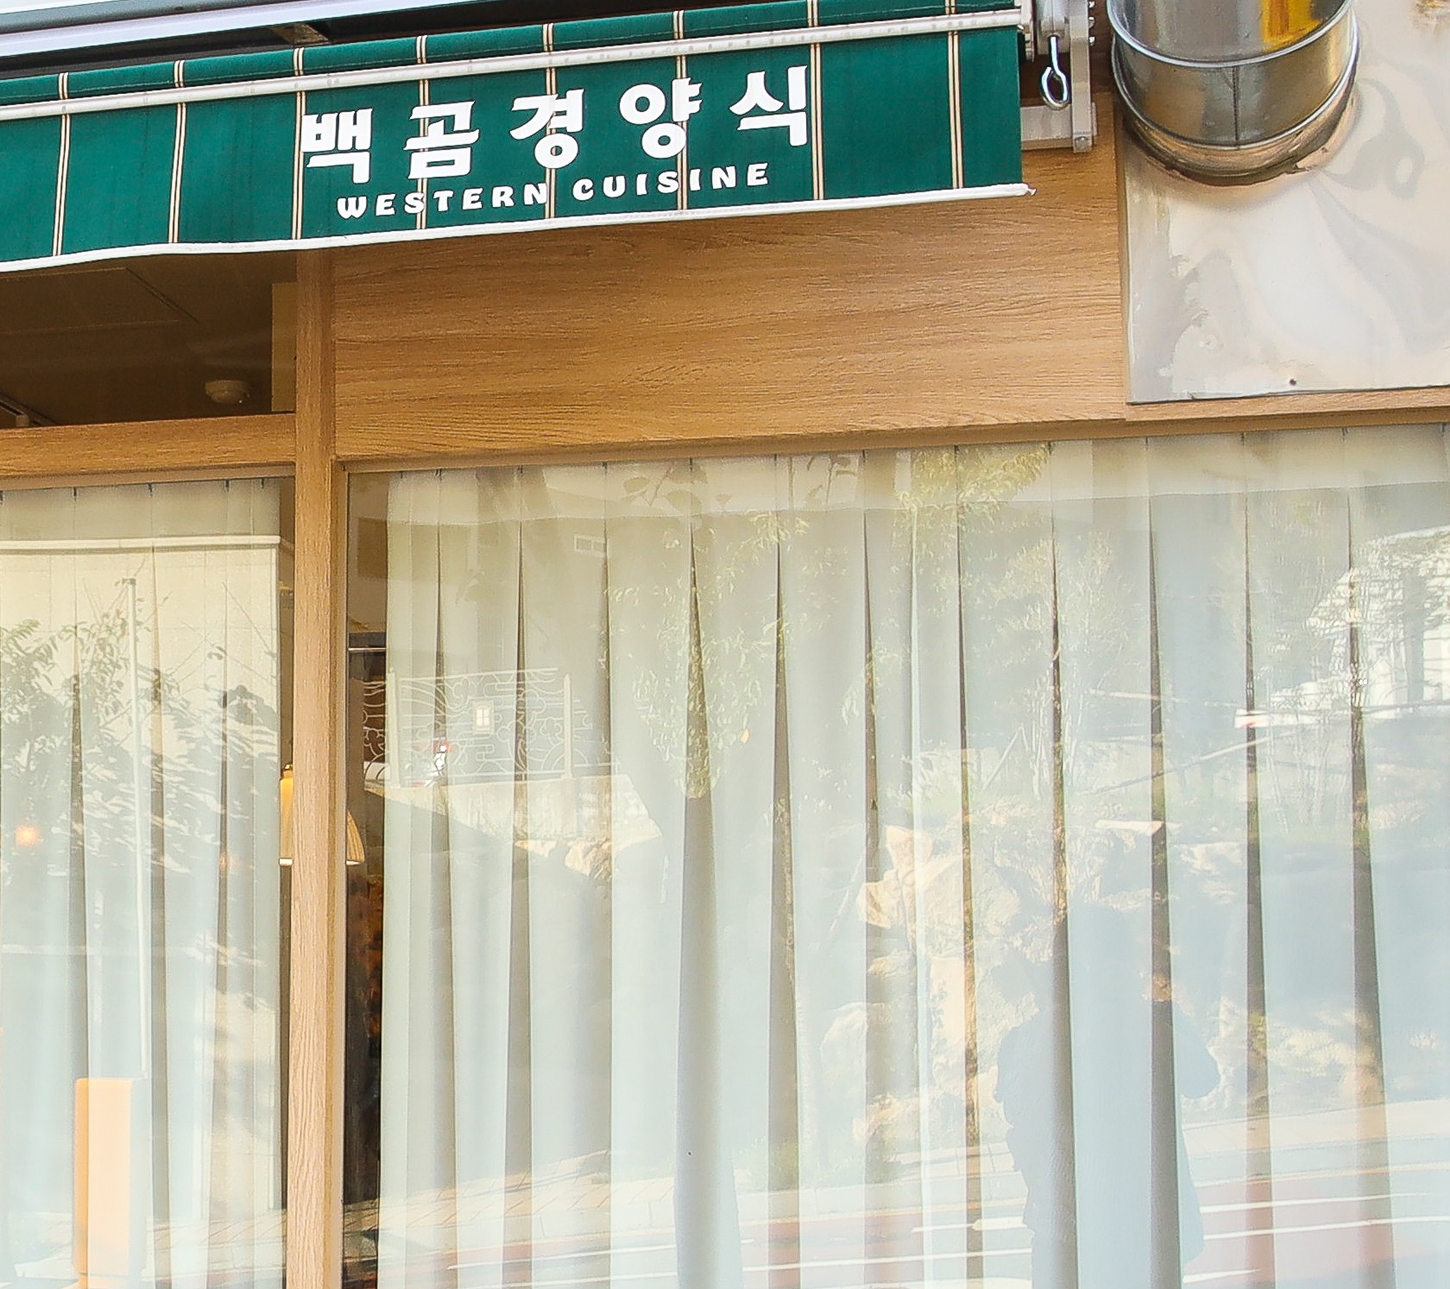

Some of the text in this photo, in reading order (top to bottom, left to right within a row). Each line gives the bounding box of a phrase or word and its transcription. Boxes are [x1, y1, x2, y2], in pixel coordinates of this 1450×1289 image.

[300, 65, 808, 184] 백곰경양식
[337, 162, 770, 219] WESTERN CUISINE
